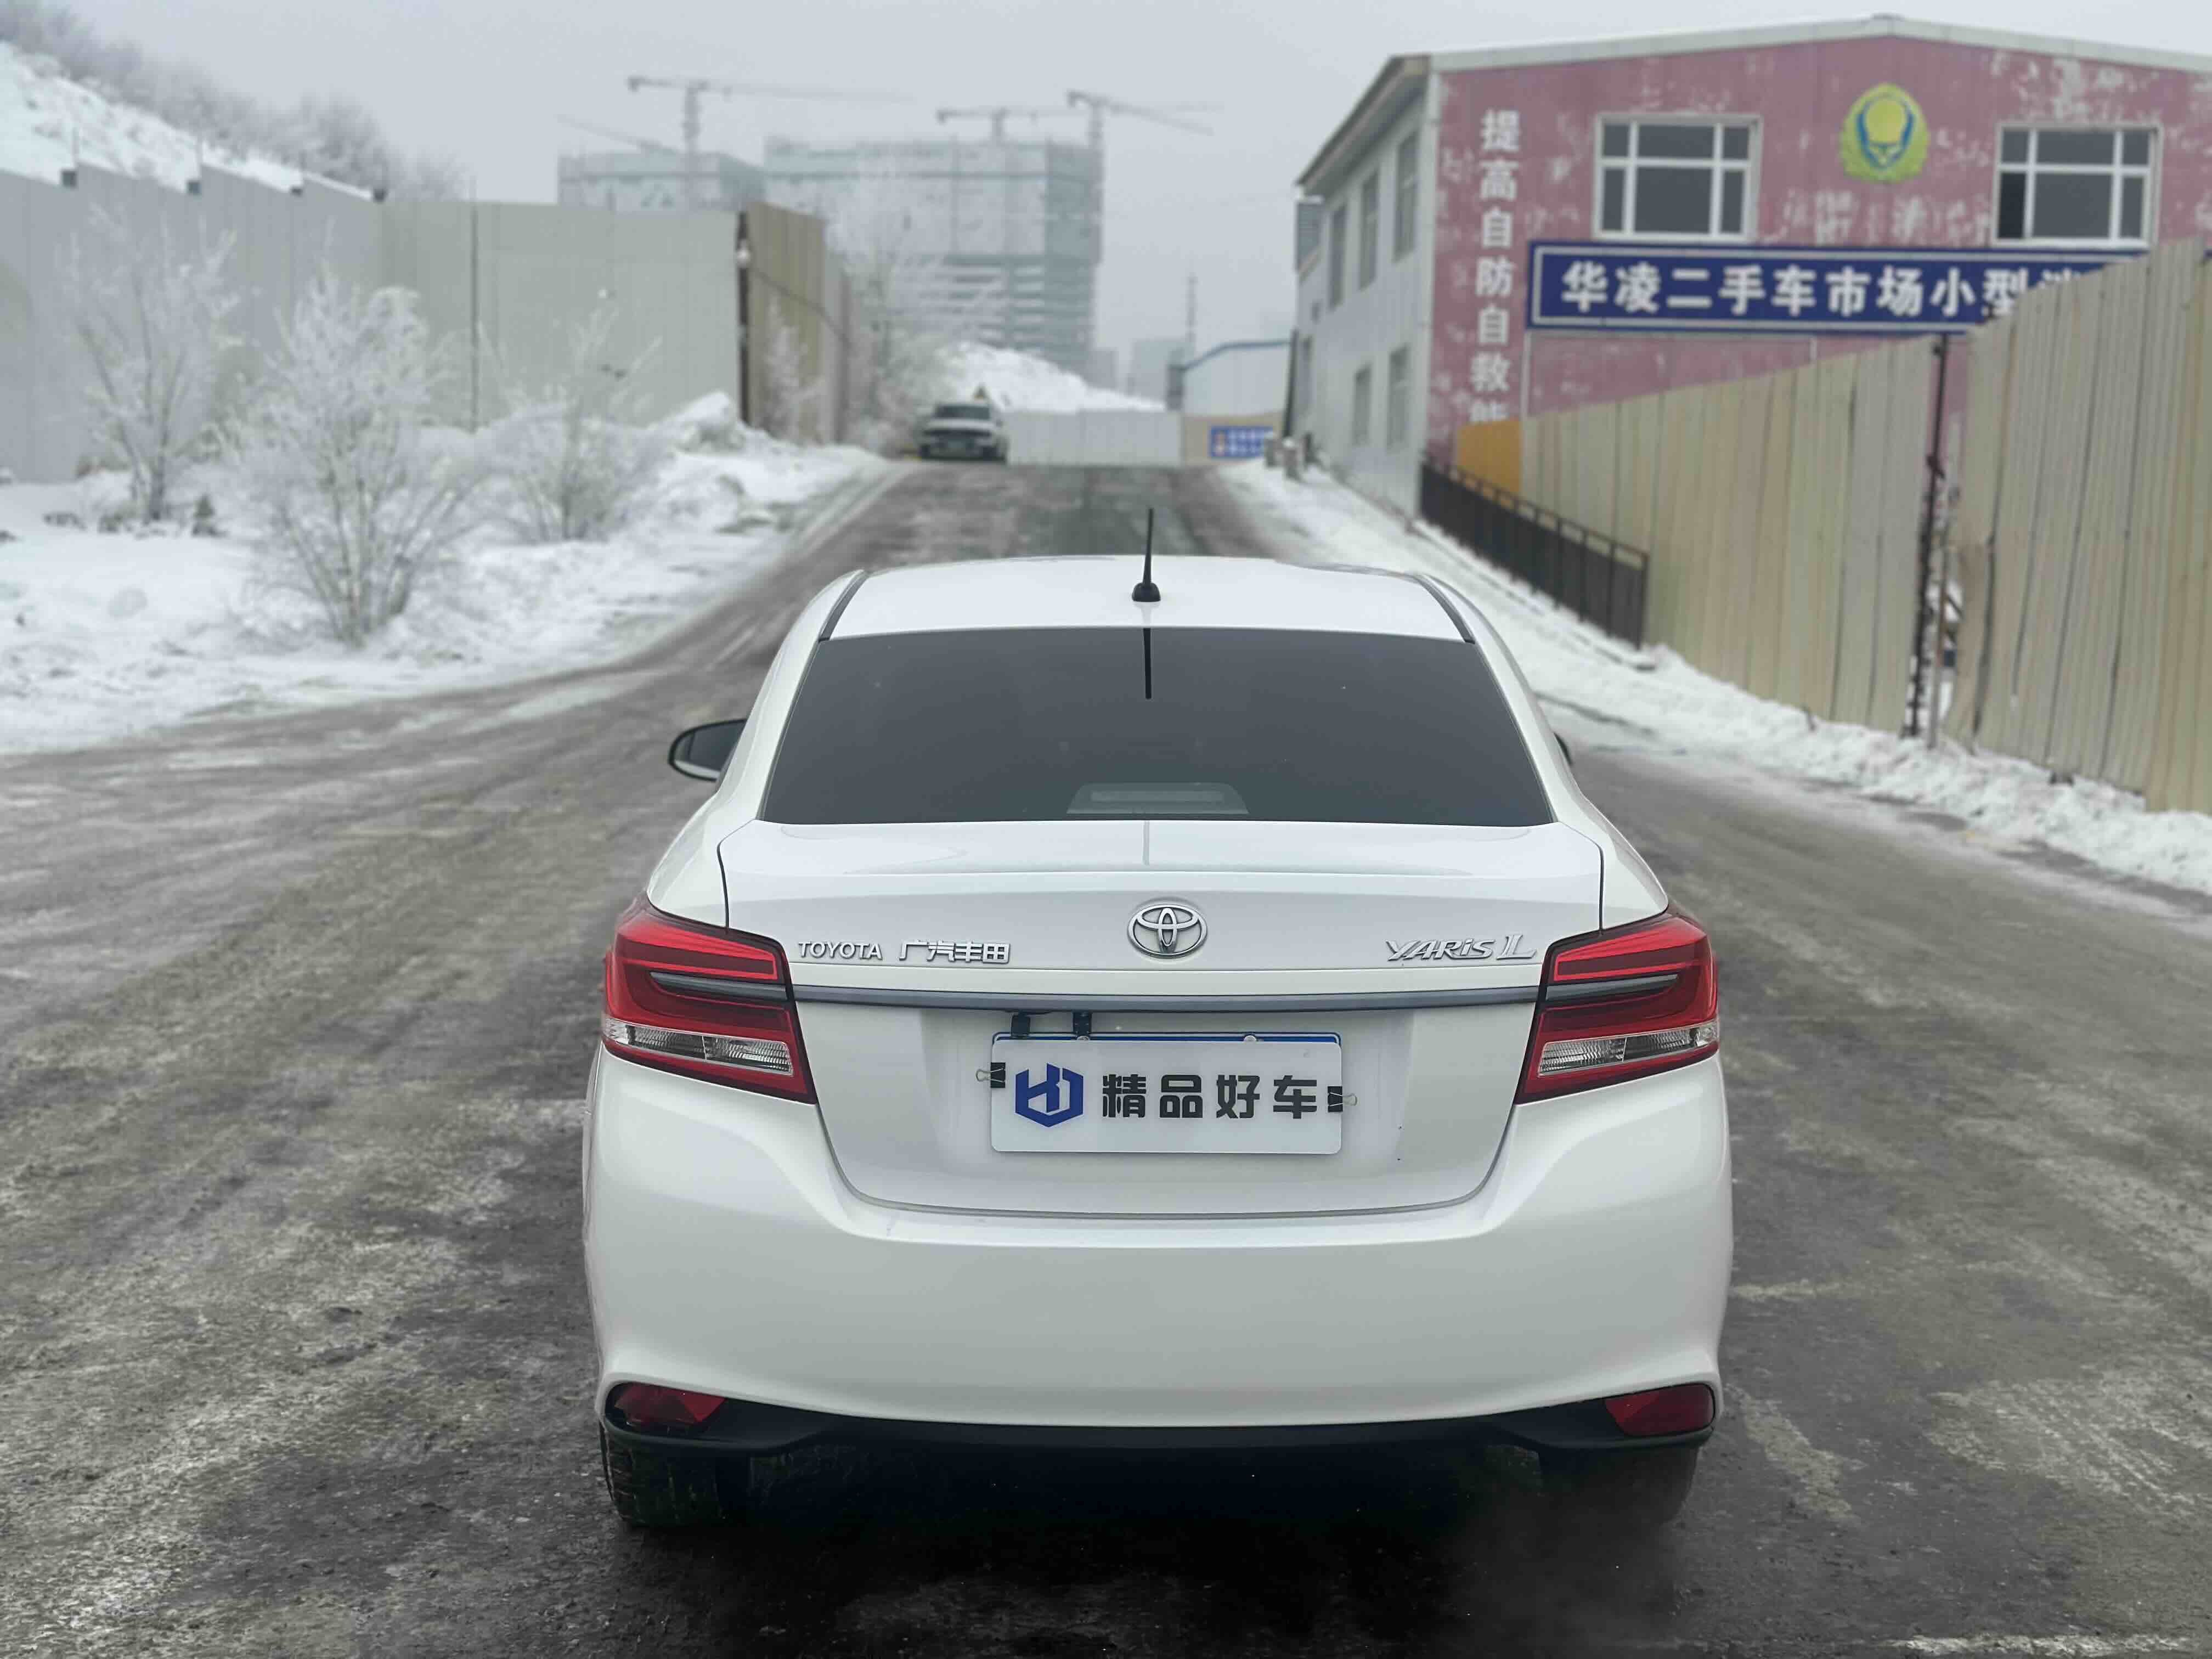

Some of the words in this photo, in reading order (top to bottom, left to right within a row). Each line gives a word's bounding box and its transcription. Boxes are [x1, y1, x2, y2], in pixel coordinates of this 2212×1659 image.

[798, 940, 884, 961] TOYOTA
[898, 939, 1011, 964] 广汽丰田
[1496, 934, 1537, 961] L
[1102, 1073, 1318, 1120] 精品好车
